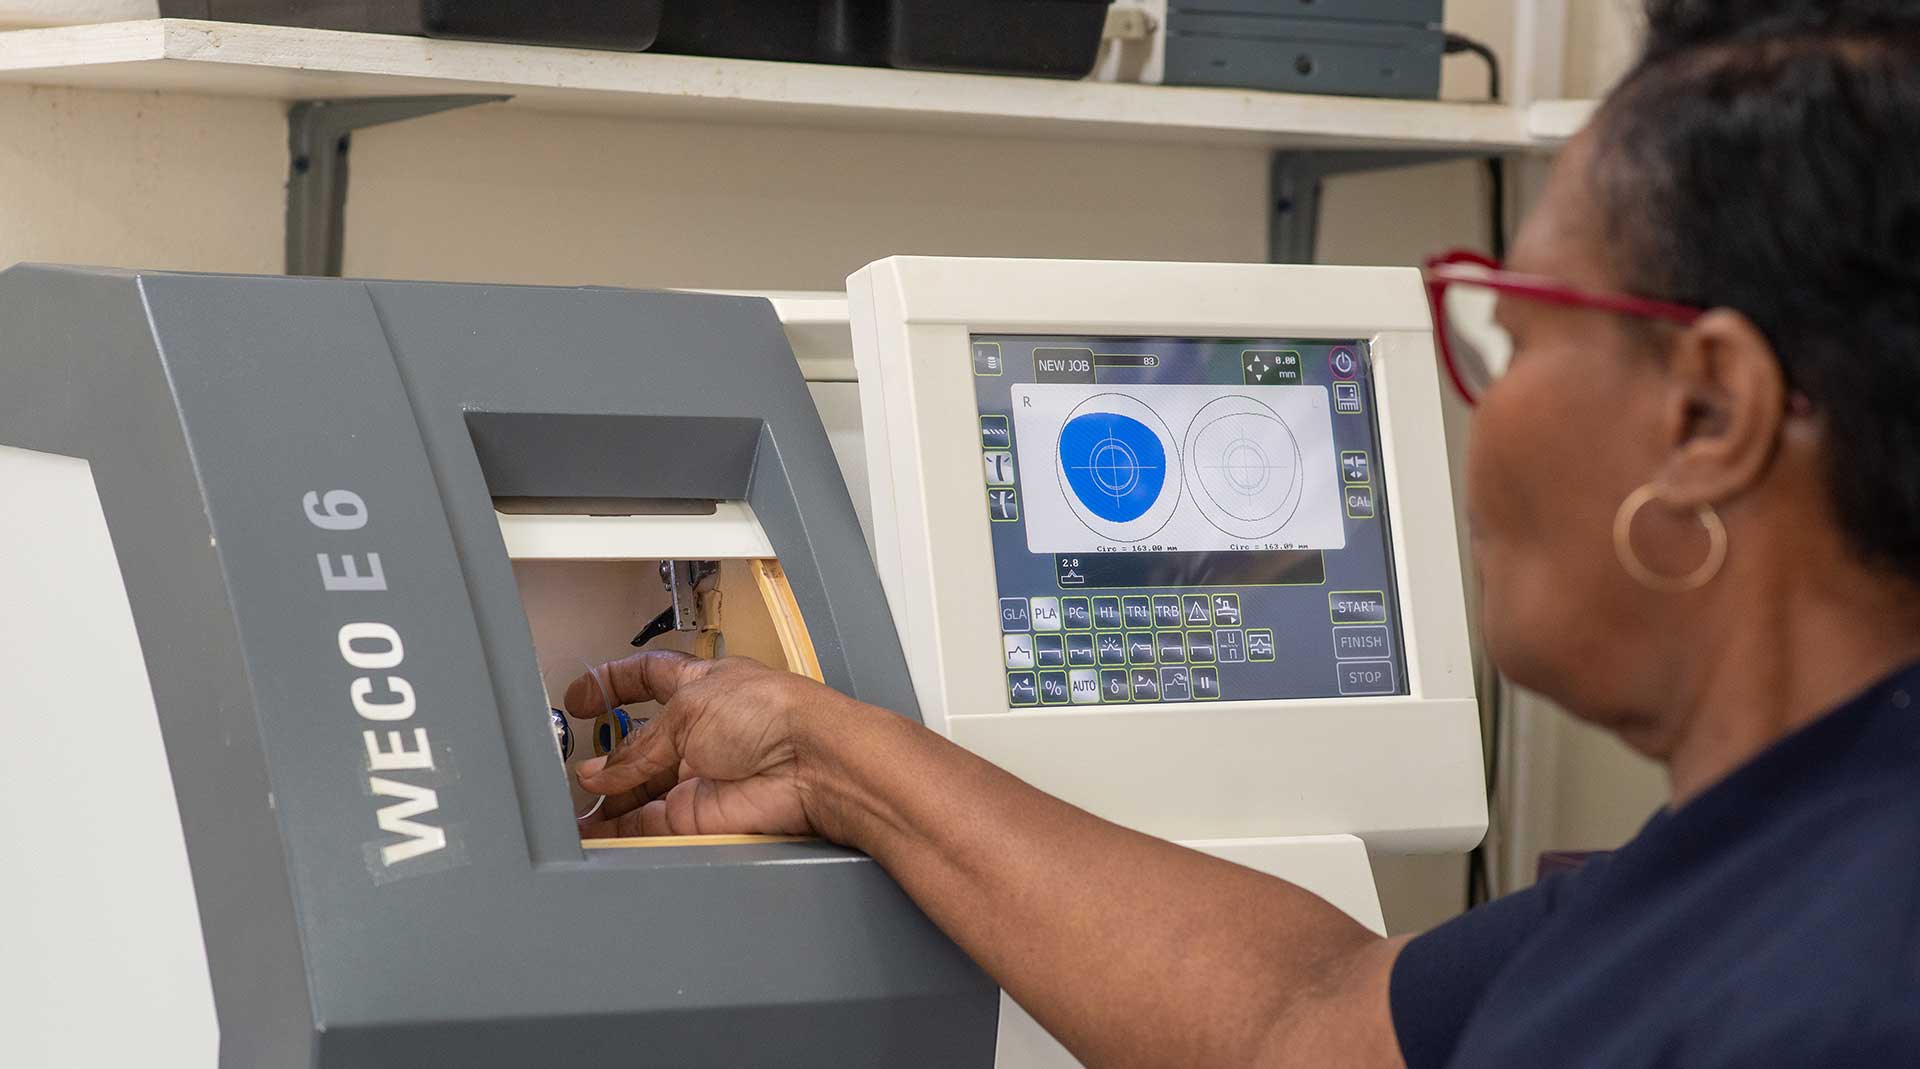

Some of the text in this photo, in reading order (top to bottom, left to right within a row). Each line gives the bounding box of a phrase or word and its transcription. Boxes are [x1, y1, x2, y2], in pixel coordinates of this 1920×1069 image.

[1038, 359, 1091, 372] NEW JOB
[1143, 356, 1155, 366] 83
[1279, 371, 1297, 379] mm
[1023, 396, 1032, 407] R
[1348, 495, 1371, 508] CAL
[1132, 544, 1163, 552] 163.00
[1003, 607, 1028, 620] GLA
[1034, 607, 1058, 619] PLA
[1068, 606, 1085, 619] PC
[1100, 606, 1114, 618] HI
[1126, 605, 1148, 617] TRI
[1155, 605, 1179, 617] TRB
[1337, 600, 1377, 614] START
[1340, 635, 1383, 649] FINISH
[1349, 671, 1382, 684] STOP
[1045, 680, 1062, 696] %
[1072, 679, 1096, 692] AUTO
[338, 622, 447, 867] WECO
